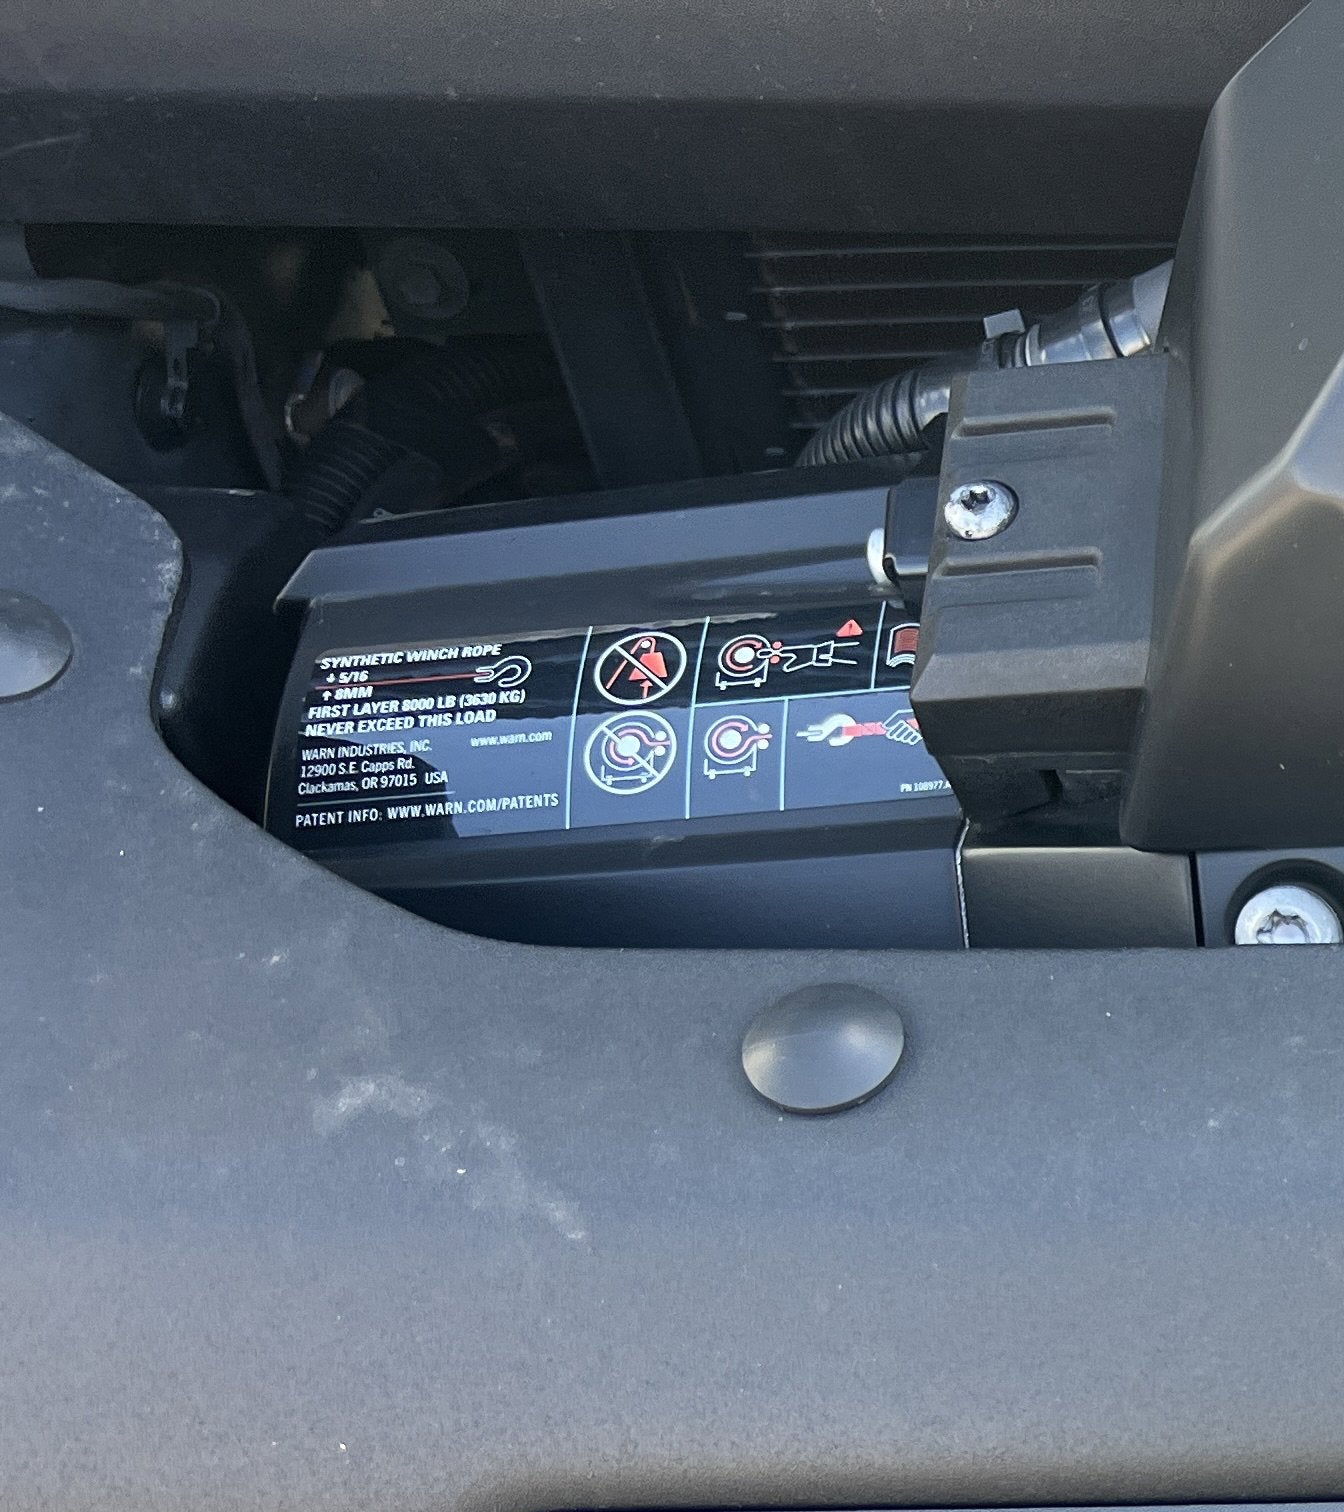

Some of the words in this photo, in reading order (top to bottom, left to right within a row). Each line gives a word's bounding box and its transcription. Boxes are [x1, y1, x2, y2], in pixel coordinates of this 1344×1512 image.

[320, 651, 405, 670] SYNTHETIC
[405, 647, 459, 663] WINCH
[461, 643, 503, 659] ROPE
[338, 670, 370, 684] 5/16
[308, 703, 351, 720] FIRST
[352, 699, 400, 716] LAYER
[401, 697, 435, 712] 8000
[436, 694, 457, 709] LB
[459, 691, 497, 709] (3630
[498, 688, 526, 704] KG)
[333, 685, 374, 701] 8MM
[304, 720, 355, 737] NEVER
[357, 716, 415, 733] EXCEED
[417, 712, 453, 728] THIS
[455, 708, 497, 725] LOAD
[301, 747, 336, 761] WARN
[337, 741, 407, 759] INDUSTRIES,
[409, 739, 433, 753] INC.
[470, 731, 553, 748] www.warn.com
[300, 763, 337, 779] 12900
[360, 759, 396, 774] Capps
[396, 756, 416, 770] Rd.
[297, 780, 360, 796] Clackamas,
[360, 777, 379, 790] OR
[379, 773, 418, 789] 97015
[424, 770, 449, 785] USA
[294, 810, 345, 828] PATENT
[347, 807, 384, 824] INFO:
[386, 792, 560, 820] WWW.WARN.COM/PATENTS
